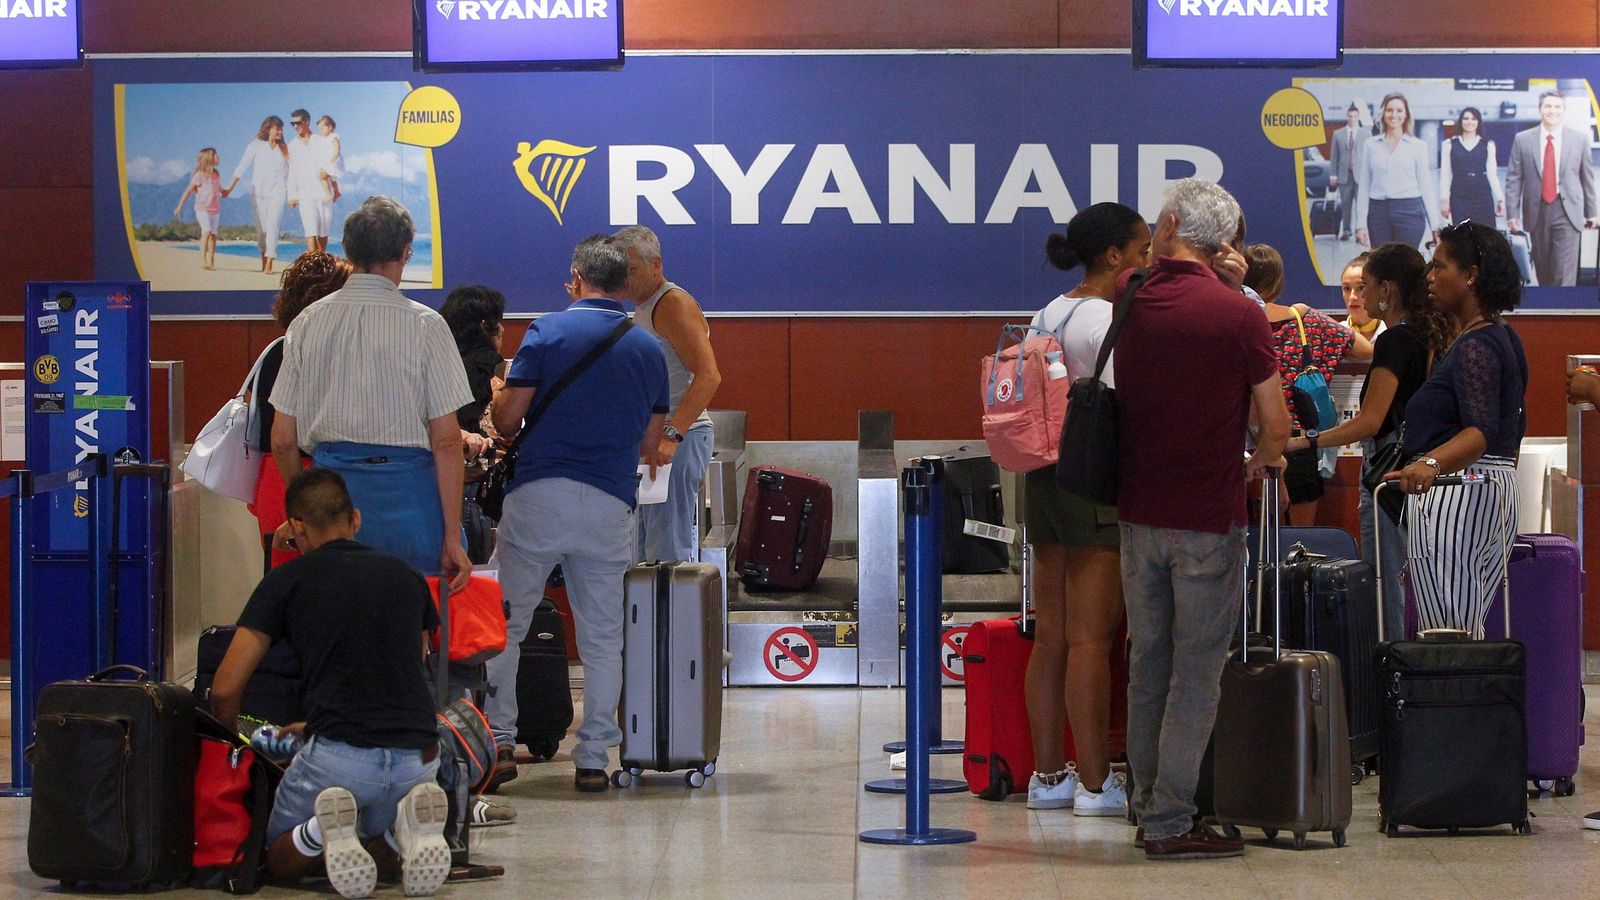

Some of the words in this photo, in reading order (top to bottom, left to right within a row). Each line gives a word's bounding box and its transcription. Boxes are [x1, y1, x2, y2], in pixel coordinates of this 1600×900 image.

[458, 0, 608, 21] RYANAIR
[1179, 0, 1329, 17] RYANAIR
[402, 110, 455, 124] FAMILIAS
[1264, 113, 1319, 127] NEGOCIOS
[609, 143, 1224, 226] RYANAIR
[39, 359, 59, 375] BVB
